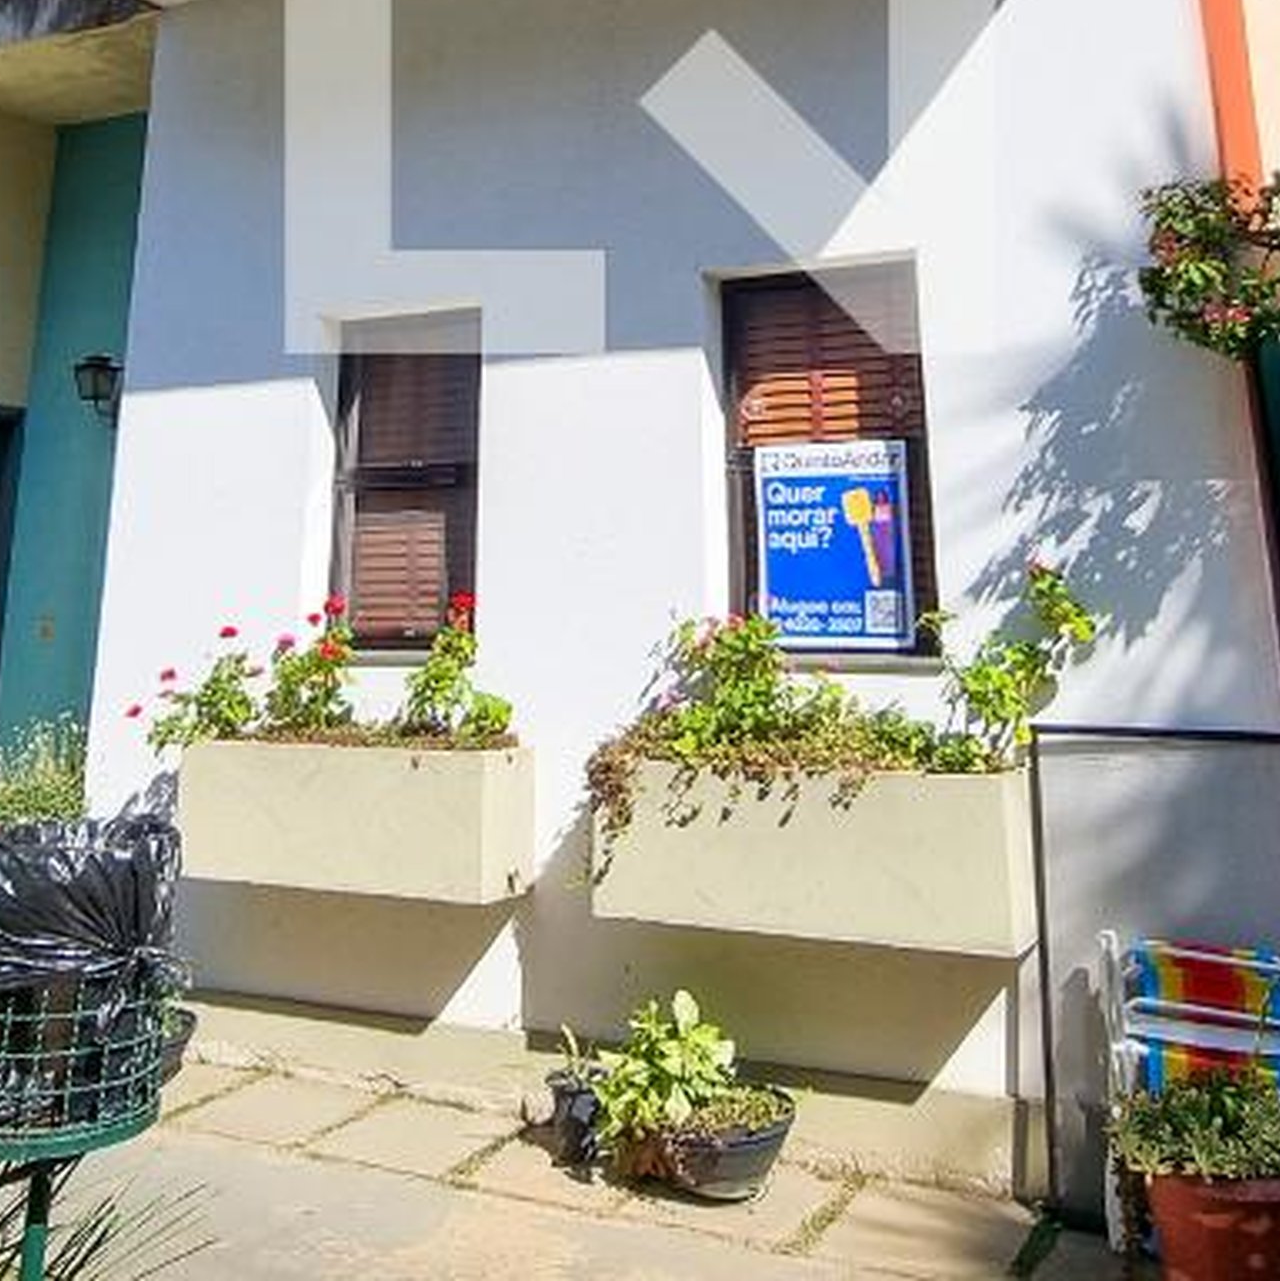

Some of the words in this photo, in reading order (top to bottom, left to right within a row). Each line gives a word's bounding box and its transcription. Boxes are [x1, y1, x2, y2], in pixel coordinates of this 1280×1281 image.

[768, 482, 826, 504] Quer
[768, 507, 838, 526] morar
[768, 528, 832, 554] aqui?
